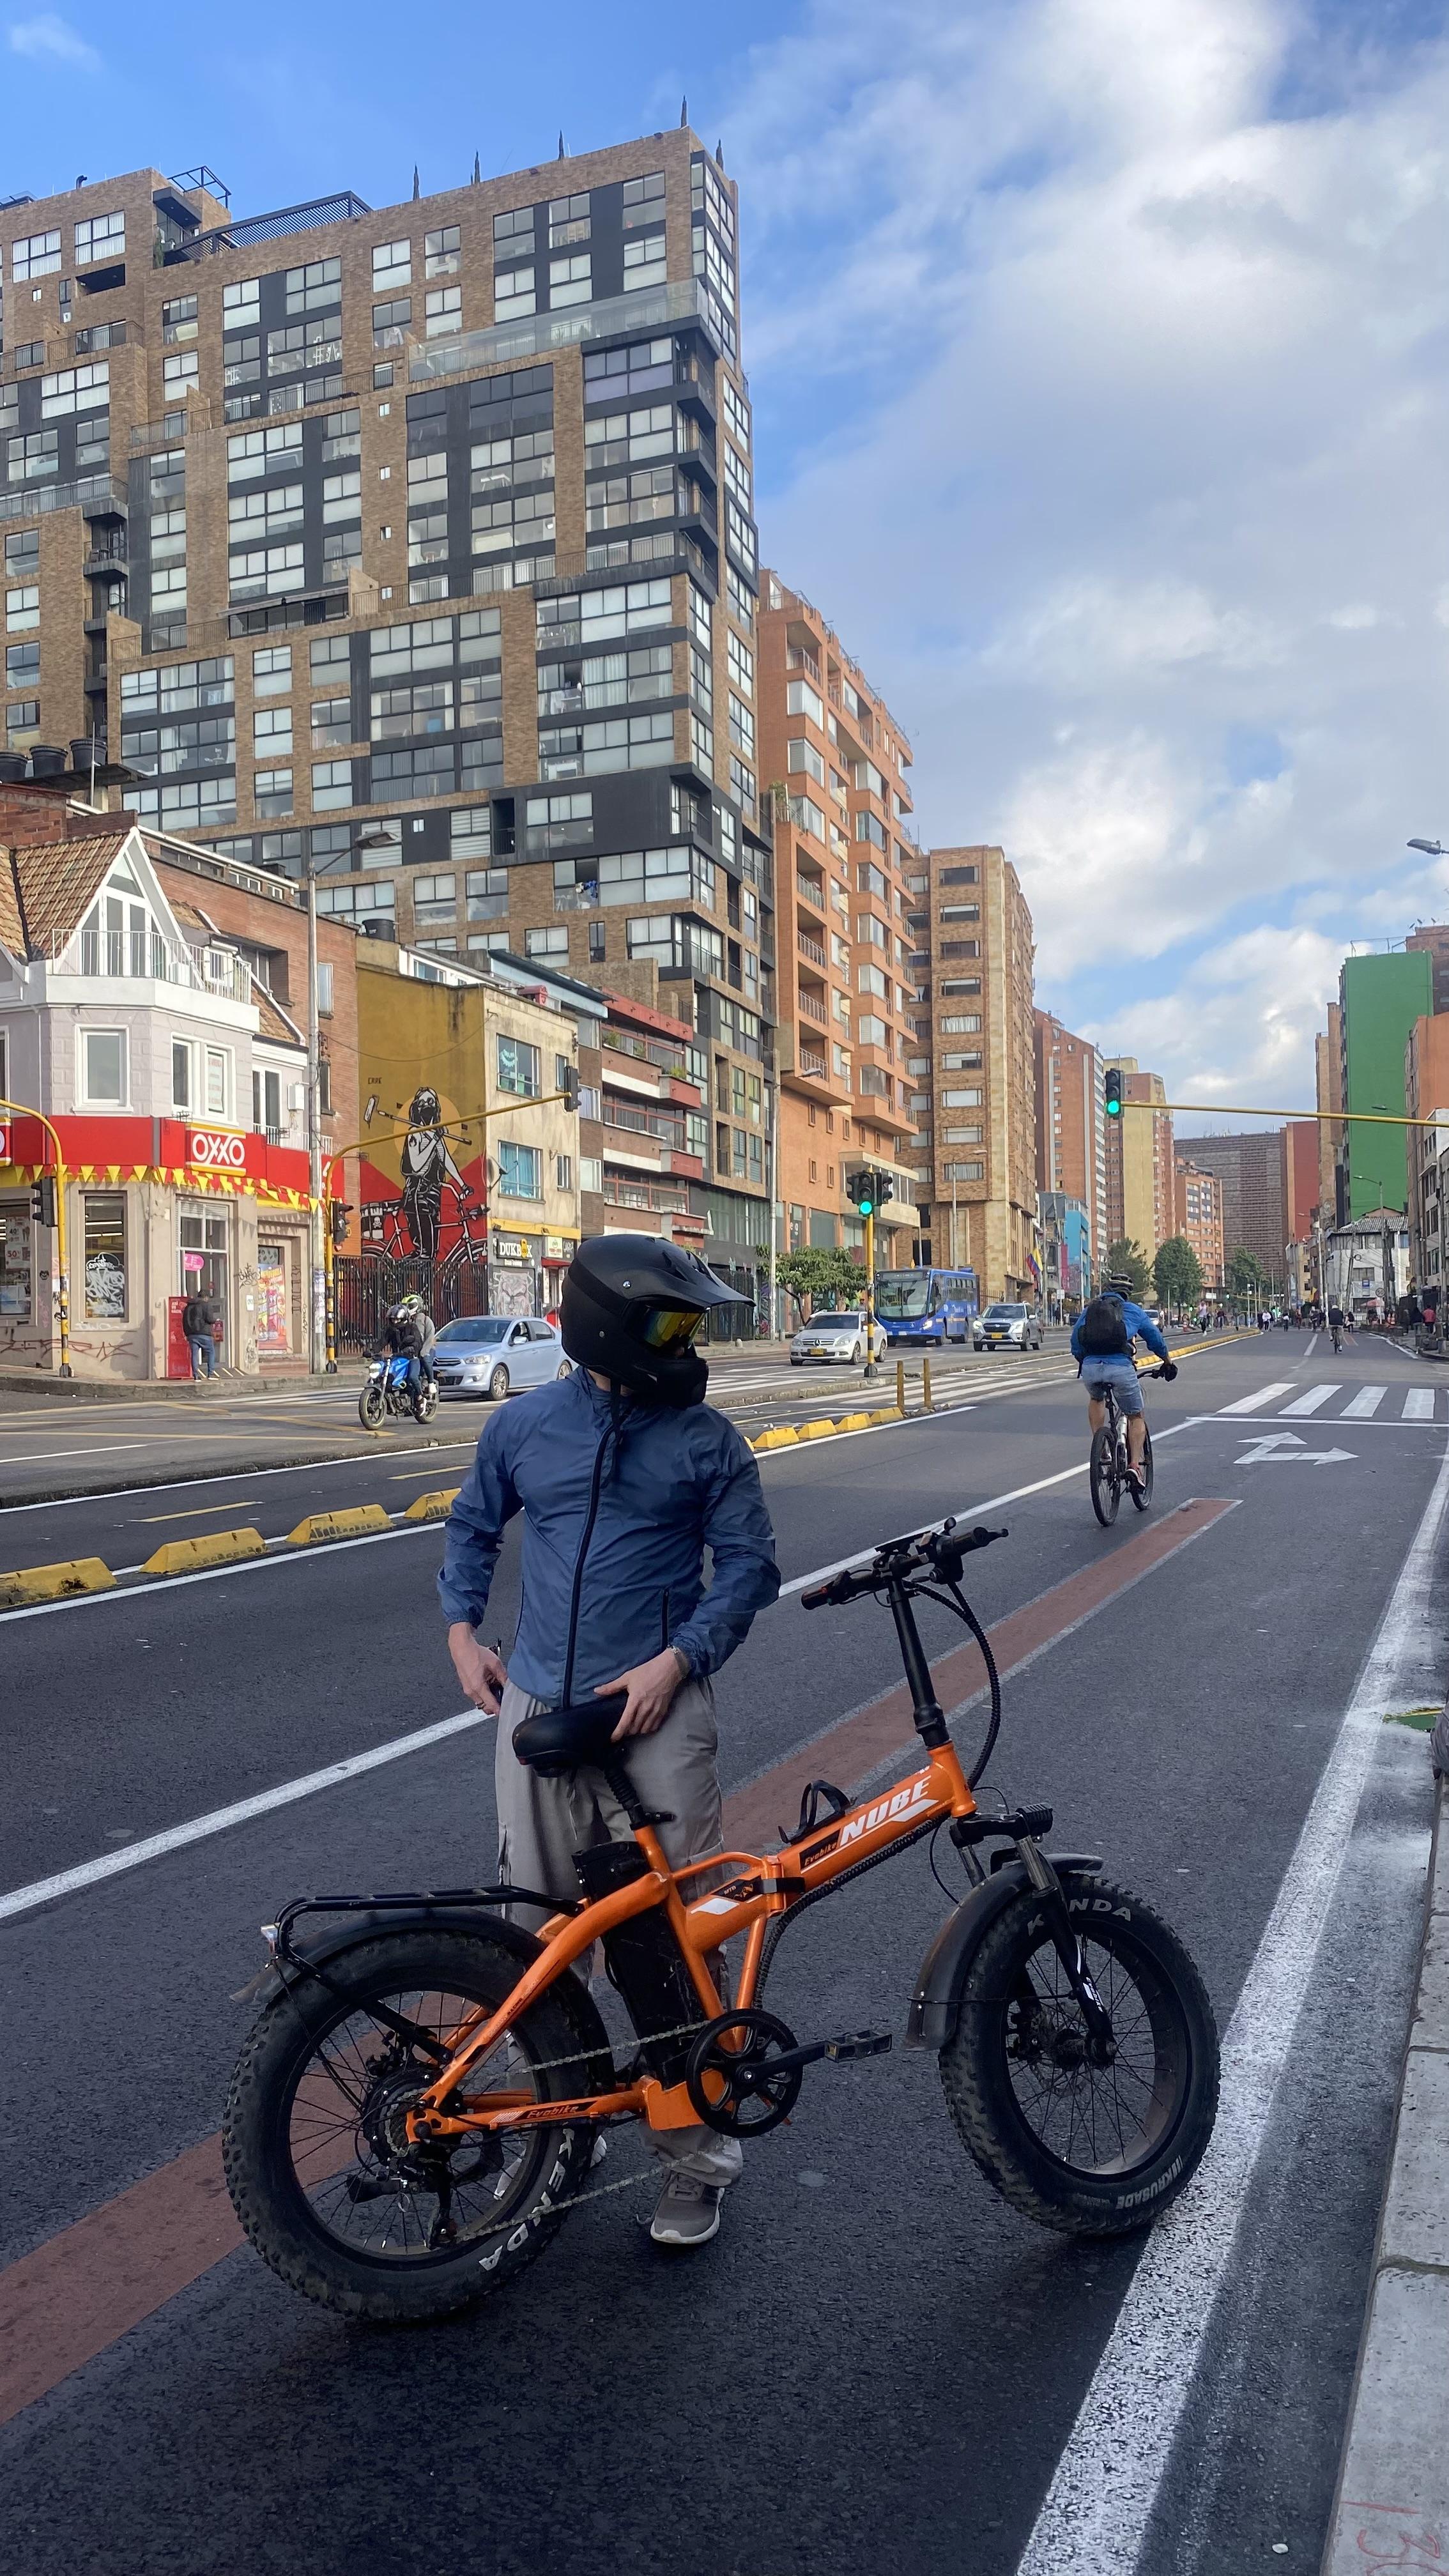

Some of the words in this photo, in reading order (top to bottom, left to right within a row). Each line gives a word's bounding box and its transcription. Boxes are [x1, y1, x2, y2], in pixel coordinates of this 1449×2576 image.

[192, 1133, 245, 1166] OXXO
[840, 1775, 931, 1846] NUBE
[804, 1842, 837, 1866] Evobike
[1027, 1897, 1131, 1937] KNDA
[526, 2105, 579, 2119] Evobike
